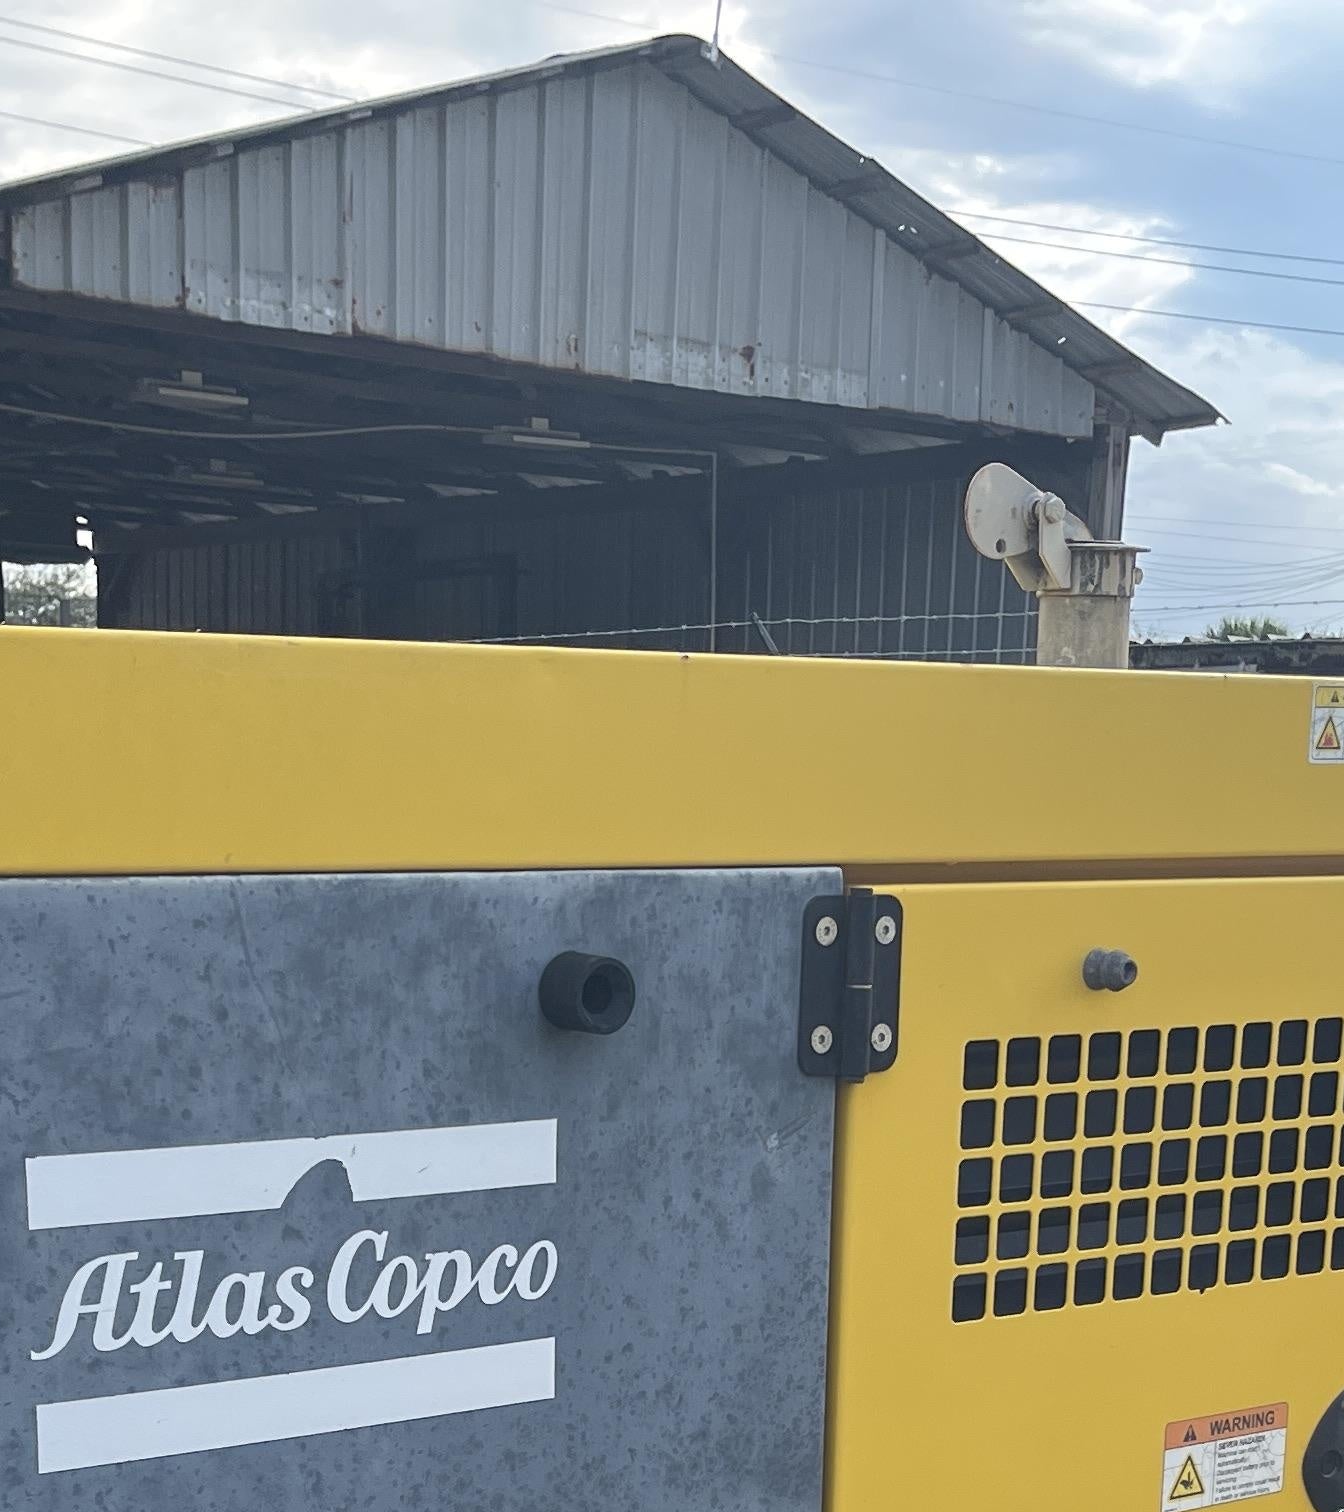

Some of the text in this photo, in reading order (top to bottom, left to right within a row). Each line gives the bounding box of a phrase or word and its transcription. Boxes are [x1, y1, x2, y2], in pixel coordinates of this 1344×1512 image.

[30, 1229, 558, 1361] Atlas Copco
[1210, 1411, 1275, 1435] WARNING
